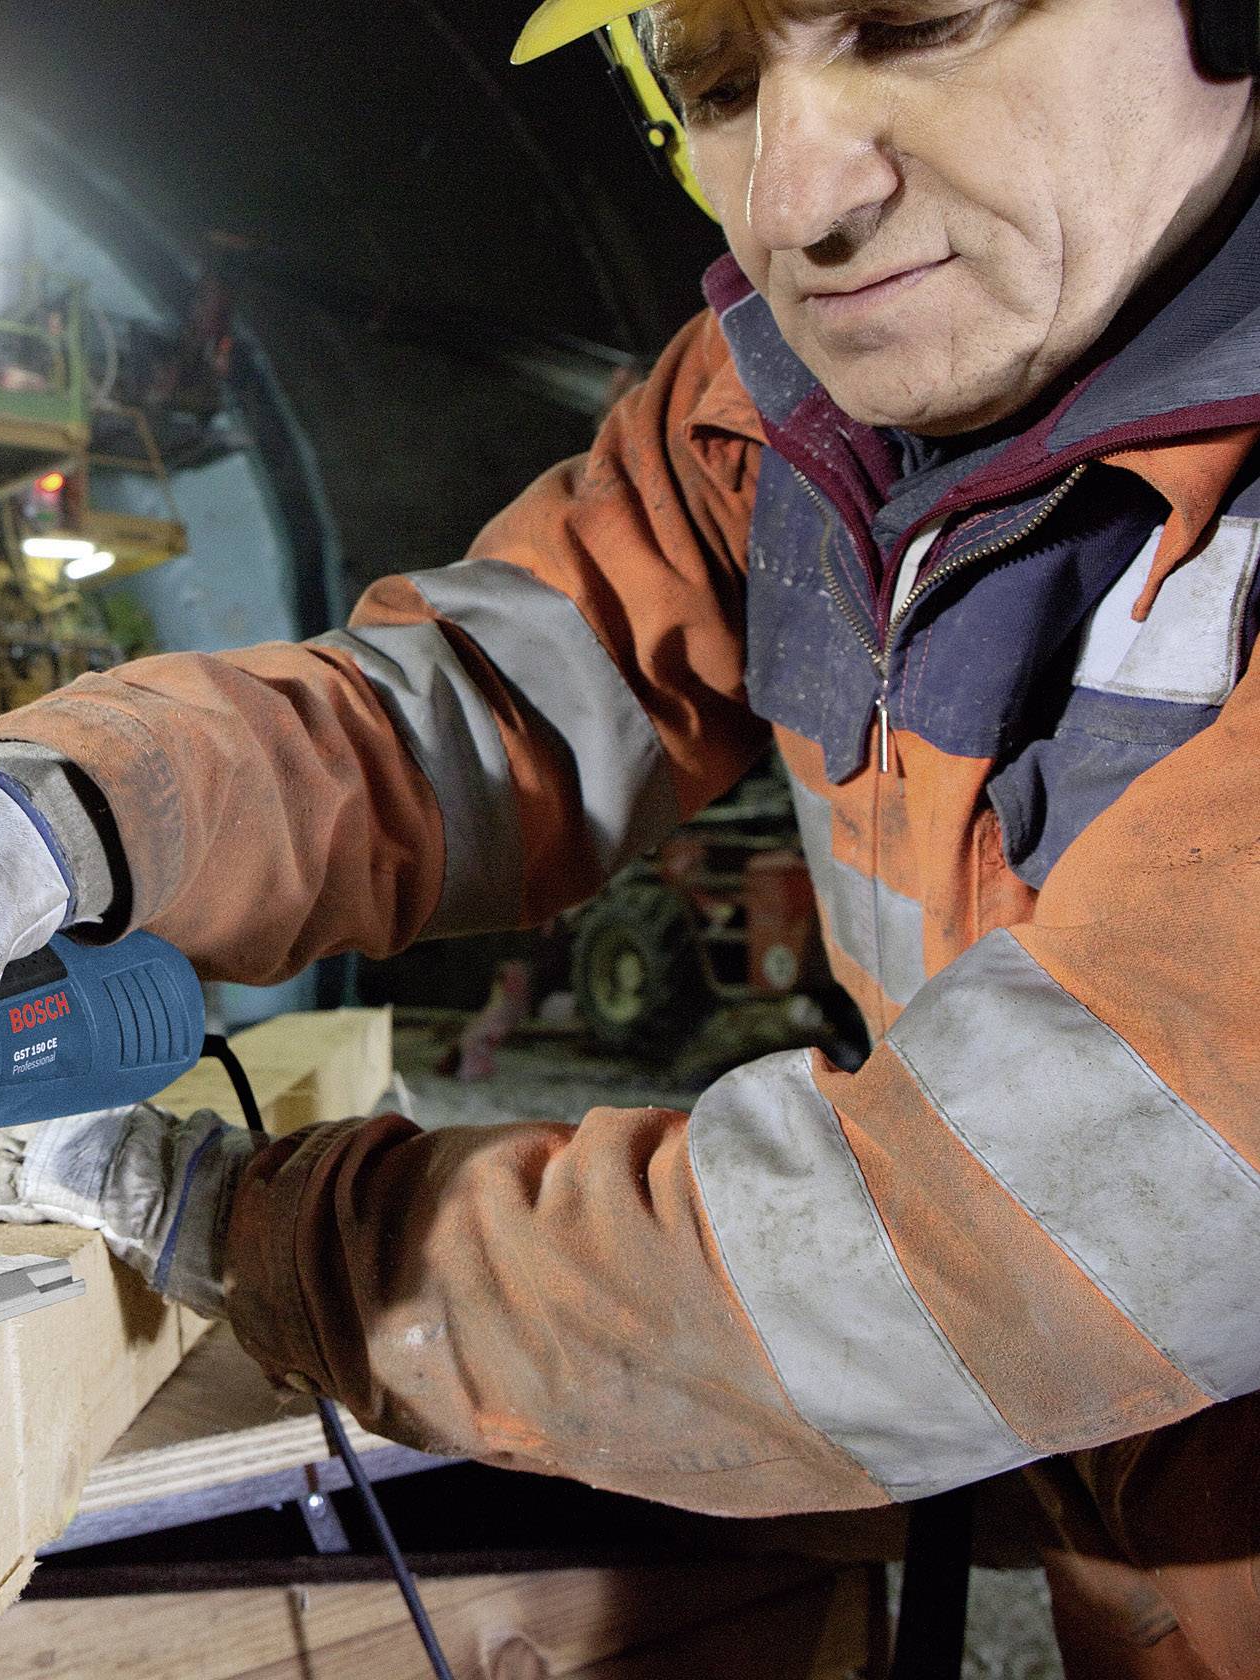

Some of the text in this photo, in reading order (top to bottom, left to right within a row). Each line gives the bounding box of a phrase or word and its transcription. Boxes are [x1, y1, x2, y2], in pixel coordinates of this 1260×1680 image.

[9, 991, 71, 1034] BOSCH
[13, 1037, 58, 1062] GST 150 CE
[12, 1050, 56, 1075] Professional
